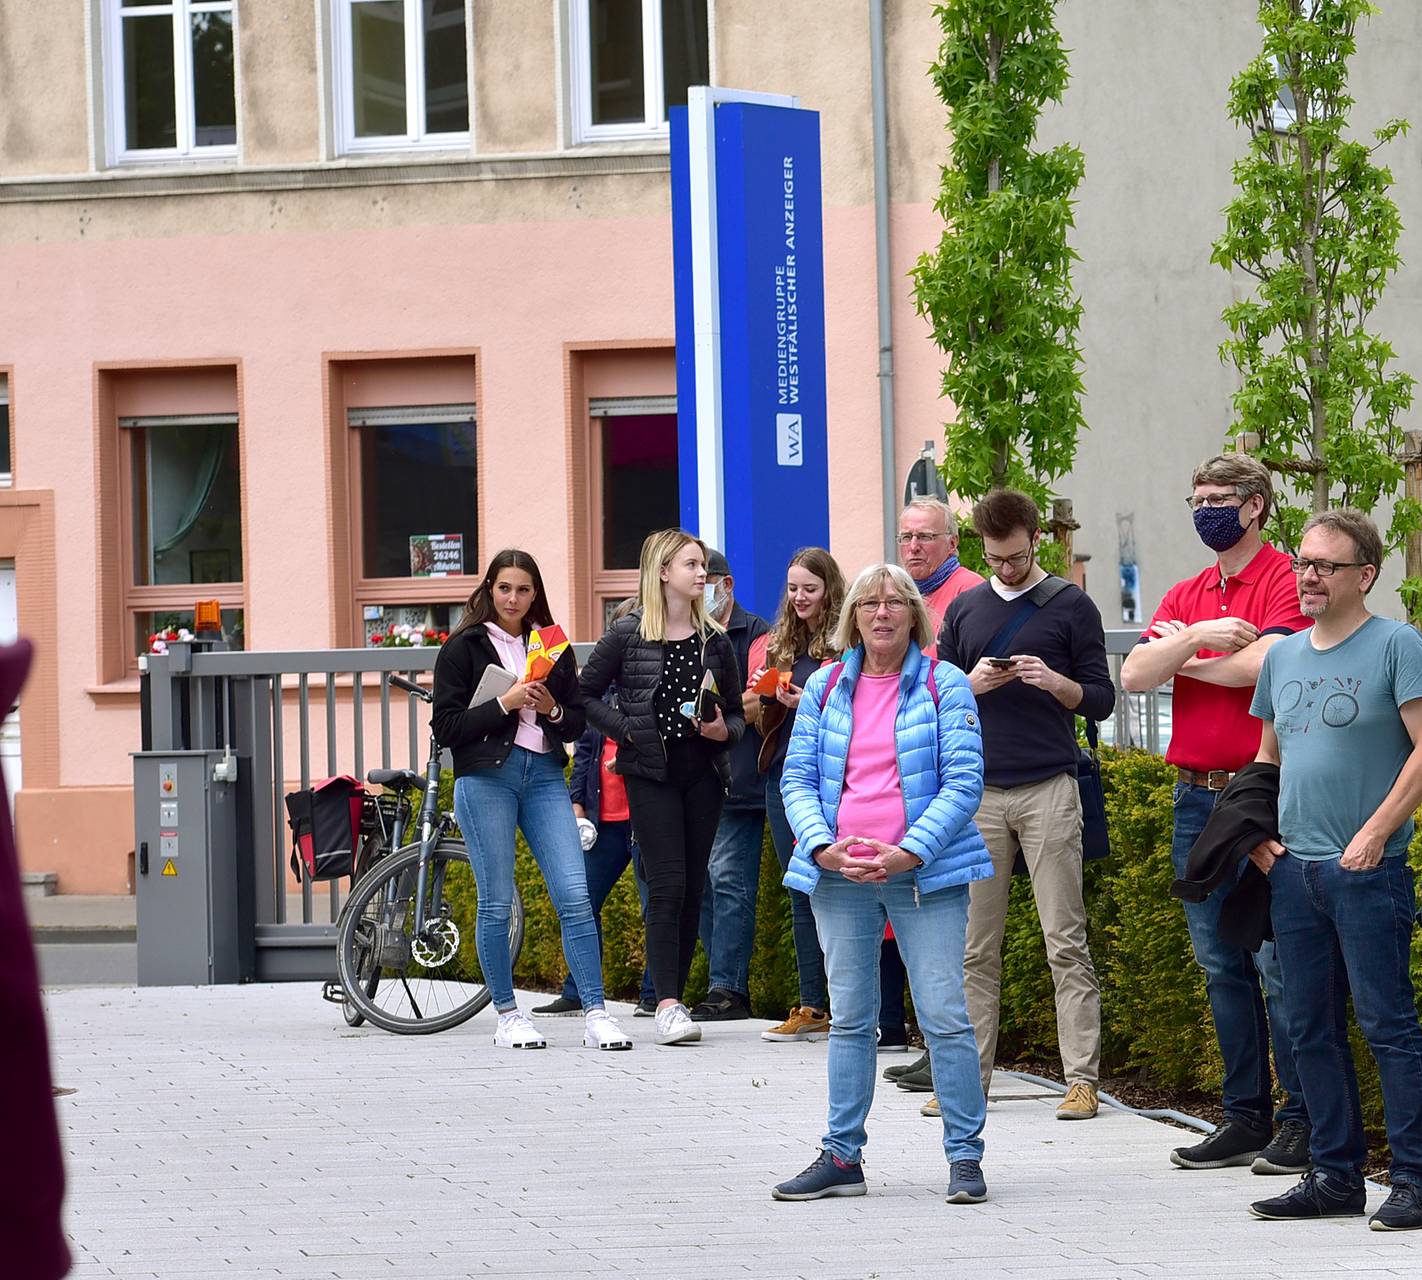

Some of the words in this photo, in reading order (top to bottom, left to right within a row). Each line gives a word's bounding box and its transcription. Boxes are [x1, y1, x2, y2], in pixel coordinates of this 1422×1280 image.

[783, 155, 796, 251] ANZEIGER
[775, 265, 788, 405] MEDIENGRUPPE
[786, 254, 800, 405] WESTFÄLISCHER
[788, 418, 800, 460] WA
[433, 551, 459, 560] 26246
